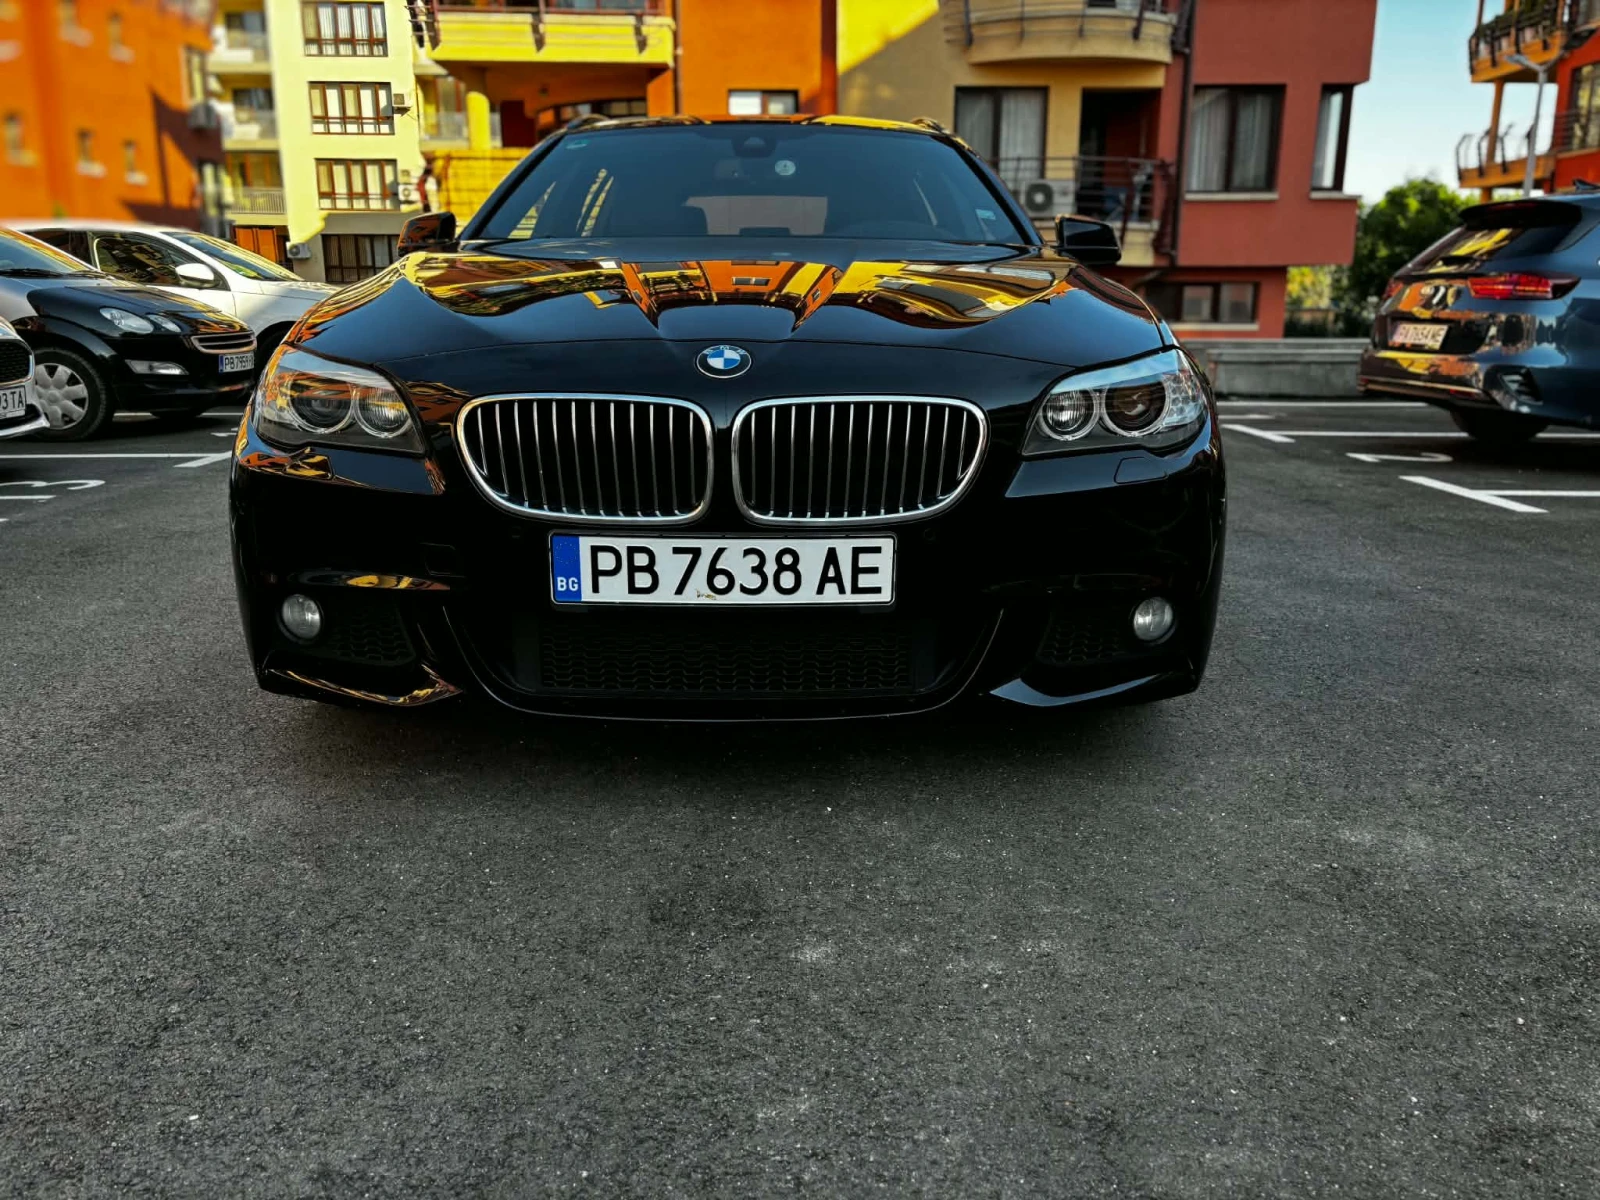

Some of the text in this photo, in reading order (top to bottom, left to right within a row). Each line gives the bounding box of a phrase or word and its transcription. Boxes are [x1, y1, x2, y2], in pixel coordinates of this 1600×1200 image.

[10, 390, 25, 409] TA
[589, 544, 883, 596] PB 7638 AE
[557, 577, 579, 592] BG
